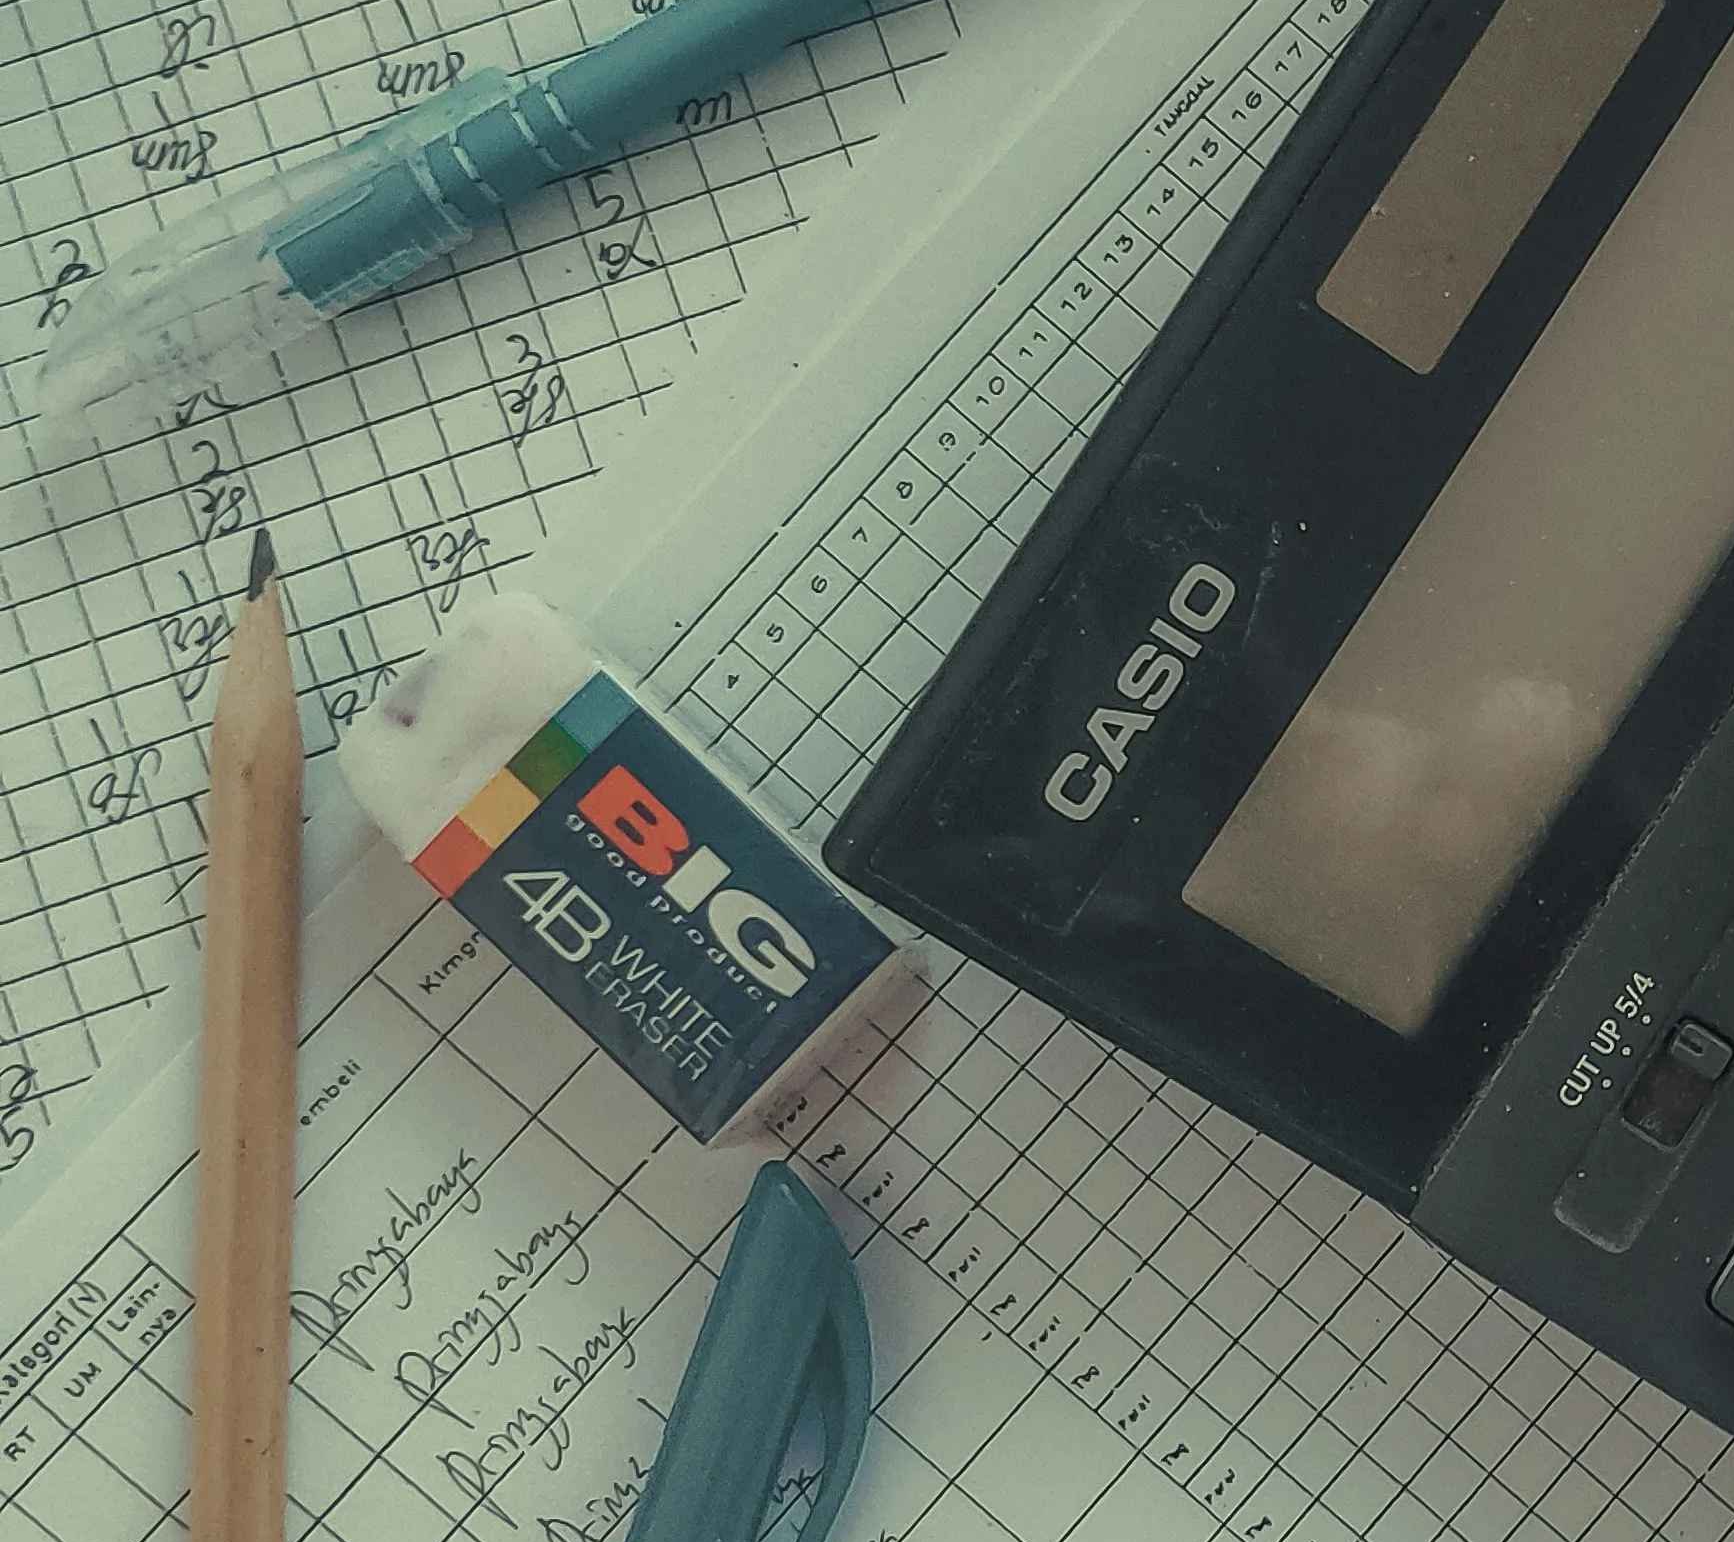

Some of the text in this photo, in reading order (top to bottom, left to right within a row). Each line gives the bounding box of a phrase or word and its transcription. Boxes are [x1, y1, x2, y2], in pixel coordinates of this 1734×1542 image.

[766, 623, 784, 643] 5
[811, 575, 827, 594] 6
[851, 526, 868, 543] 7
[976, 376, 1005, 405] 10
[1019, 332, 1047, 357] 11
[1060, 282, 1093, 311] 12
[1103, 234, 1133, 263] 13
[1147, 188, 1175, 215] 14
[1188, 137, 1218, 167] 15
[1232, 90, 1262, 120] 16
[1275, 40, 1302, 72] 17
[1044, 563, 1236, 821] CASIO
[565, 812, 647, 887] good
[577, 764, 815, 999] BIG
[502, 870, 733, 1051] 4B WHITE
[585, 960, 708, 1081] ERASER
[1558, 971, 1657, 1110] CUT UP 5/4
[3, 1426, 37, 1464] RT
[63, 1360, 102, 1400] UM
